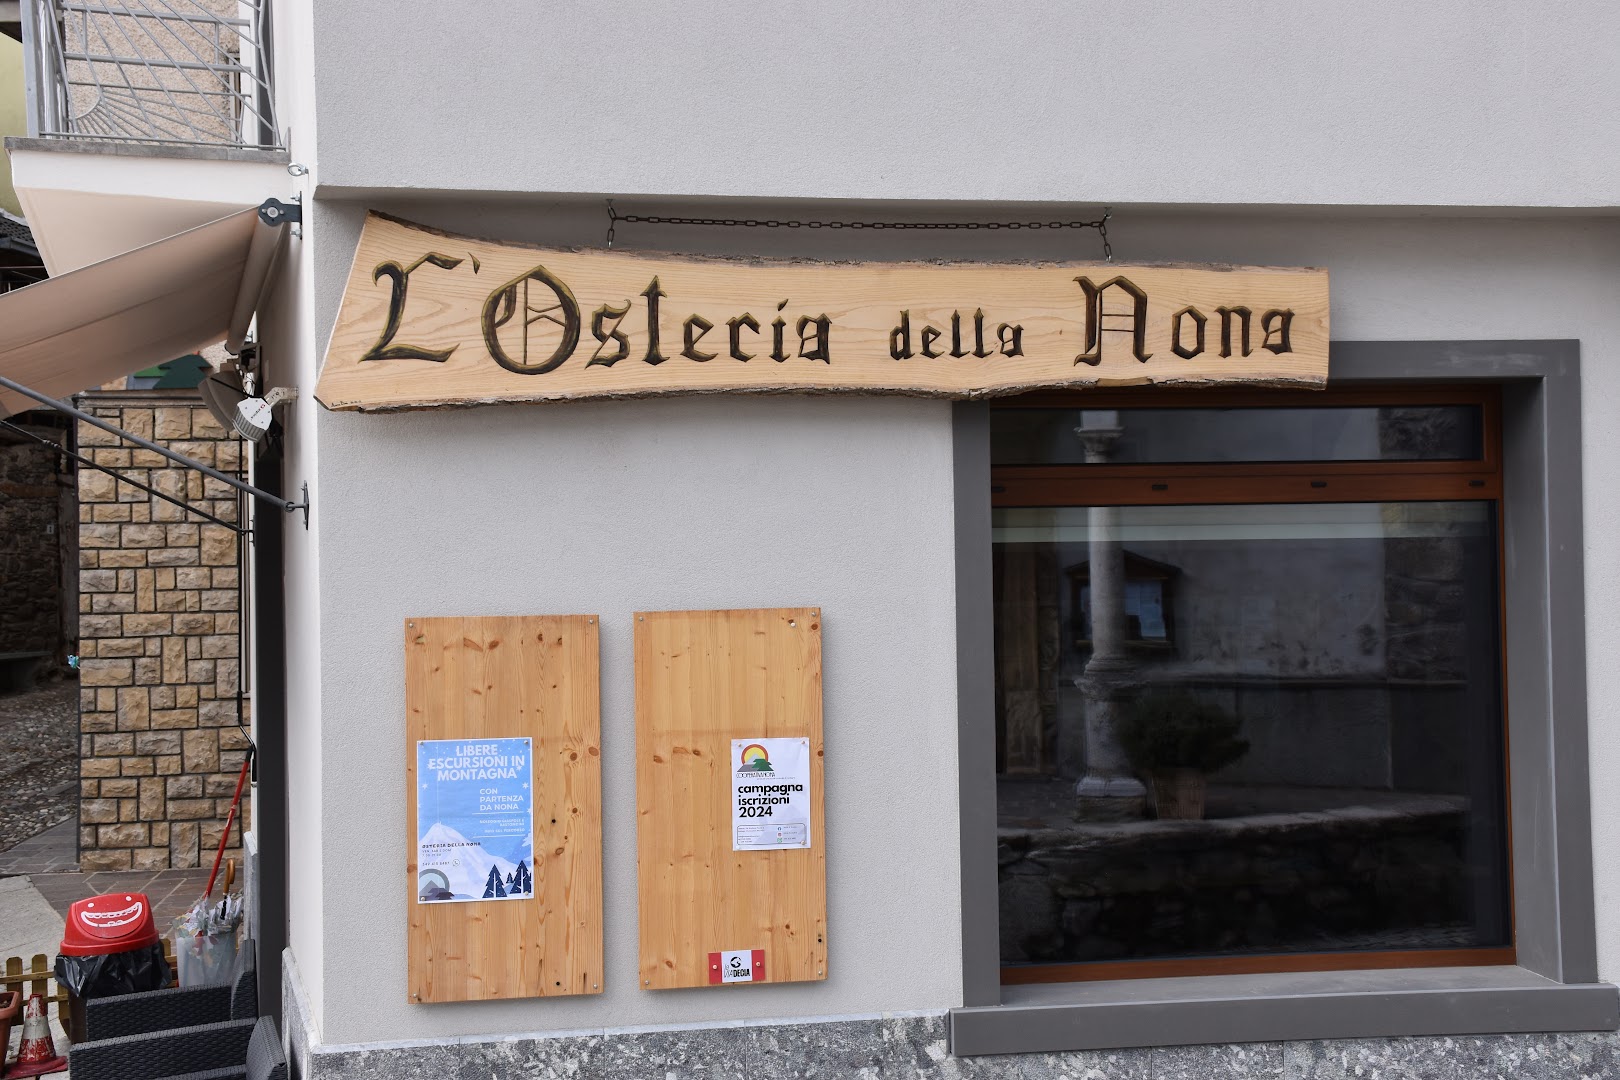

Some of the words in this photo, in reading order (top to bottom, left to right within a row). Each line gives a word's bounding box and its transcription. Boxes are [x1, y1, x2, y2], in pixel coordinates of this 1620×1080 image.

[358, 251, 832, 375] L'Osteria
[889, 307, 1025, 361] della
[1072, 275, 1295, 367] Nona
[456, 744, 498, 757] LIBERE
[428, 755, 508, 770] ESCURSIONI
[511, 755, 525, 767] IN
[437, 767, 518, 781] MONTAGNA
[738, 784, 803, 796] campagna
[479, 795, 524, 803] PARTENZA
[738, 793, 790, 806] iscrizioni
[494, 803, 519, 811] NONA
[738, 805, 773, 818] 2024
